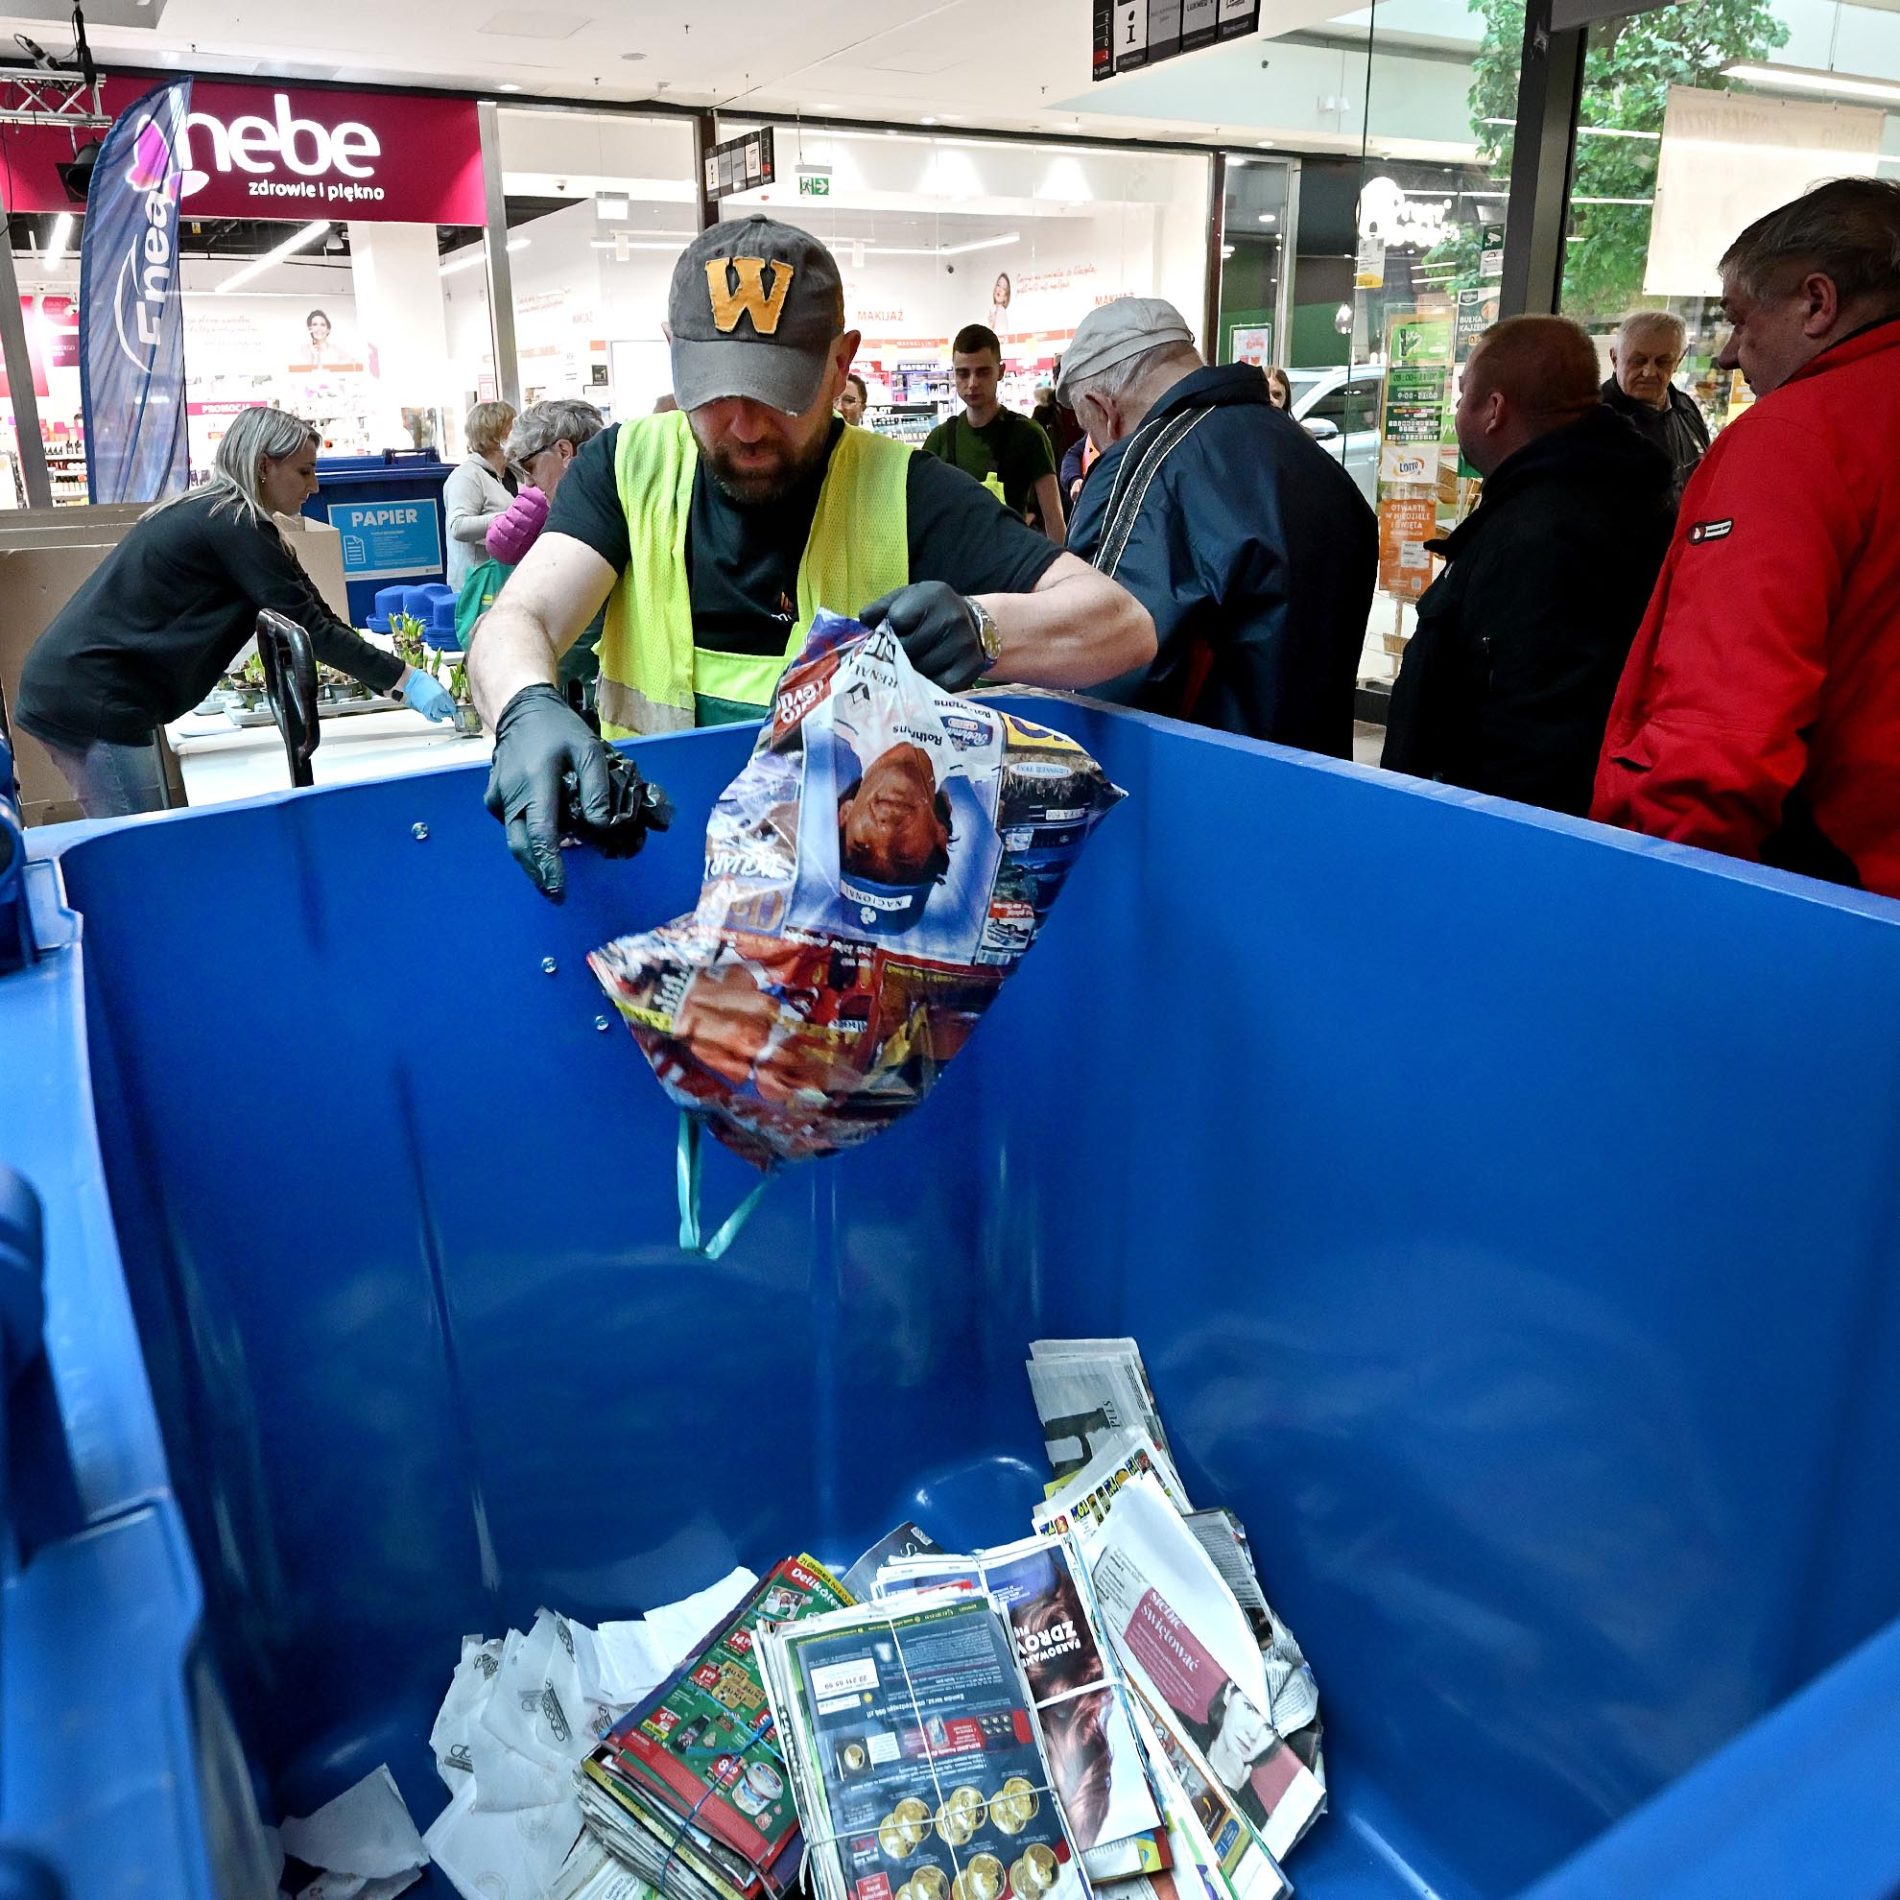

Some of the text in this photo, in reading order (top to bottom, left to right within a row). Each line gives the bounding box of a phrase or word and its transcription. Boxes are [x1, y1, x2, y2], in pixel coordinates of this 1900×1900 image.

[248, 179, 316, 198] zdrowie
[327, 182, 385, 202] piękno
[136, 190, 171, 346] Enea
[704, 256, 794, 334] W
[857, 308, 904, 322] MAKIJAŻ
[1399, 461, 1418, 473] LOTTO
[351, 508, 418, 528] PAPIER
[1391, 503, 1426, 513] OTWARTE
[1395, 520, 1423, 530] ŚWIĘTA
[1140, 1604, 1200, 1673] świętować
